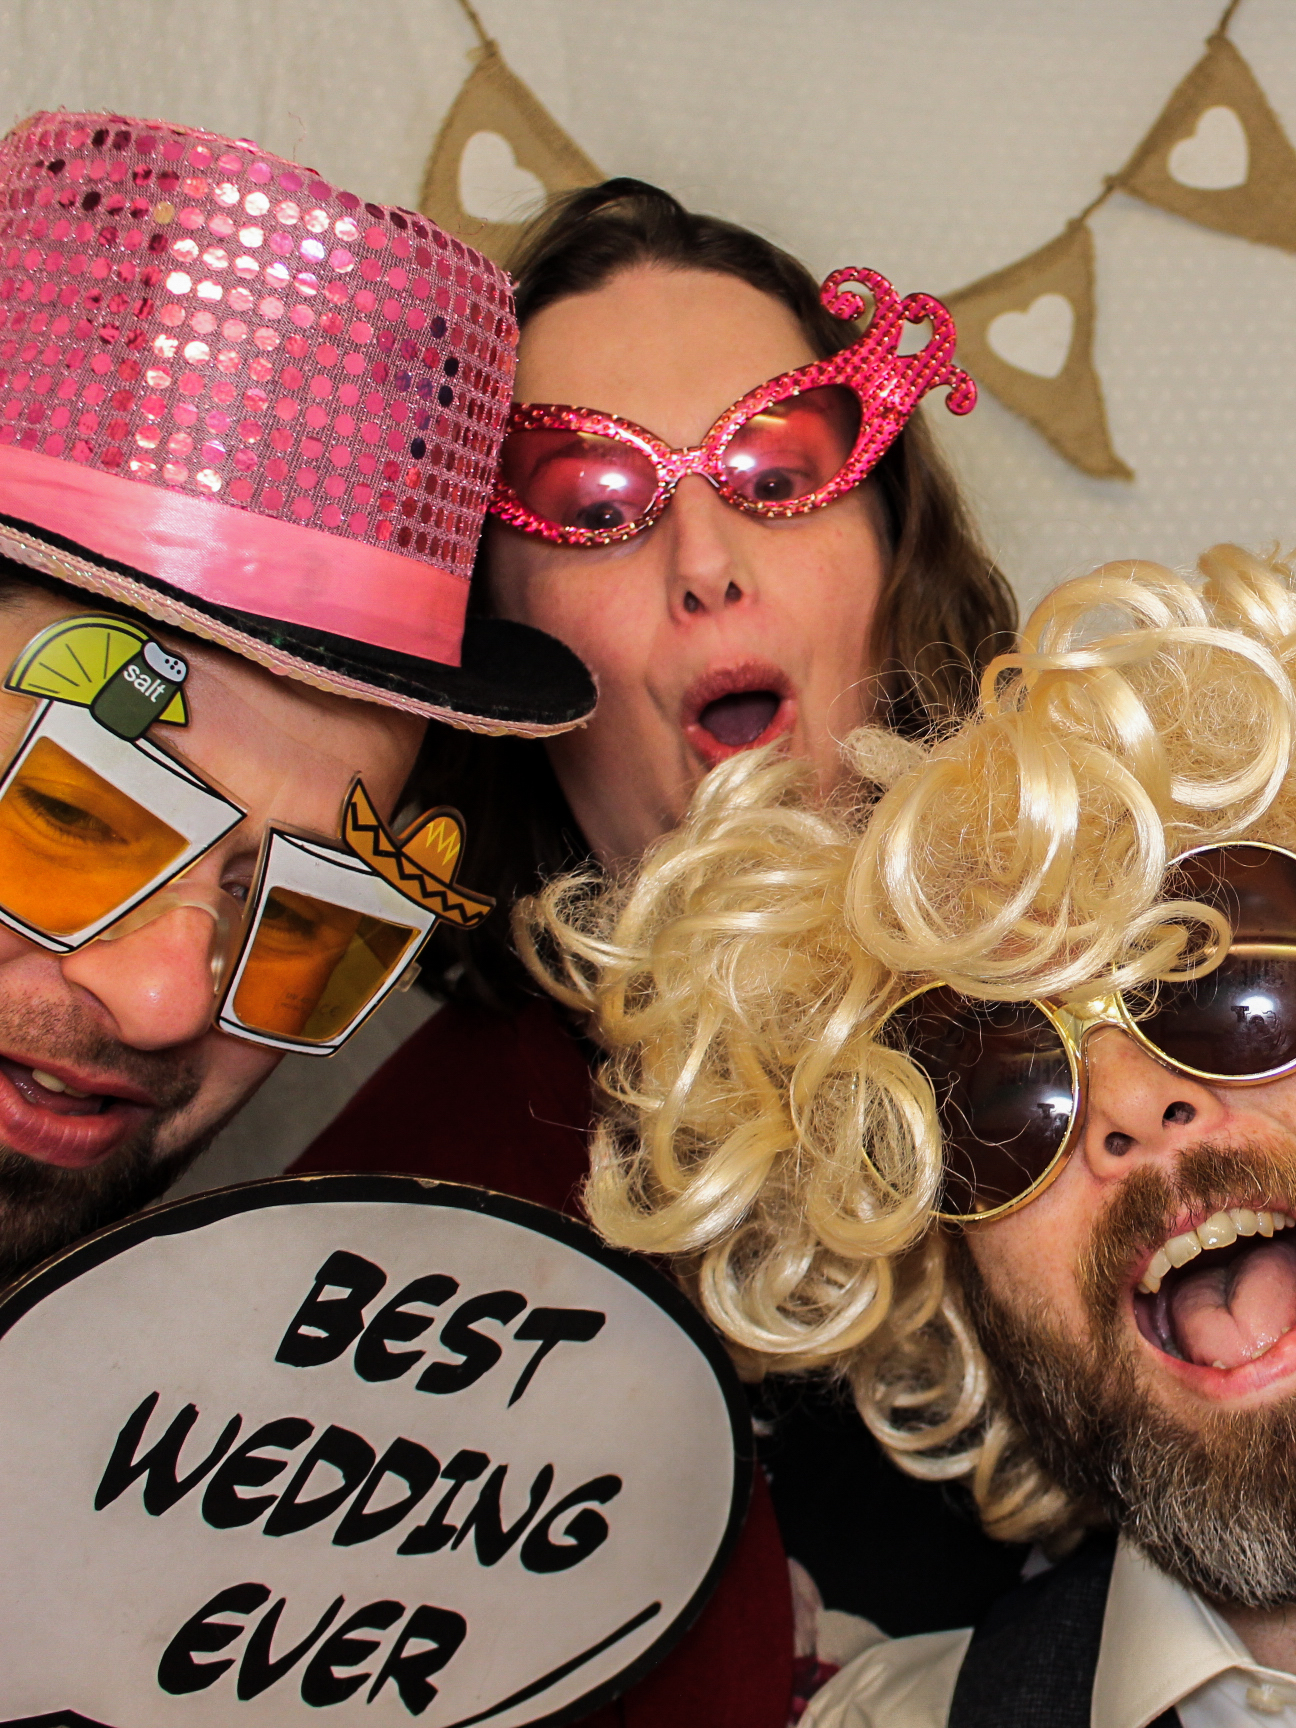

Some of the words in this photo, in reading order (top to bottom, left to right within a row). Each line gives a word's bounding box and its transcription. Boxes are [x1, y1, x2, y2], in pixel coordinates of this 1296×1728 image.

[123, 664, 166, 703] salt
[275, 1250, 606, 1409] BEST
[94, 1391, 623, 1575] WEDDING
[157, 1582, 468, 1717] EVER
